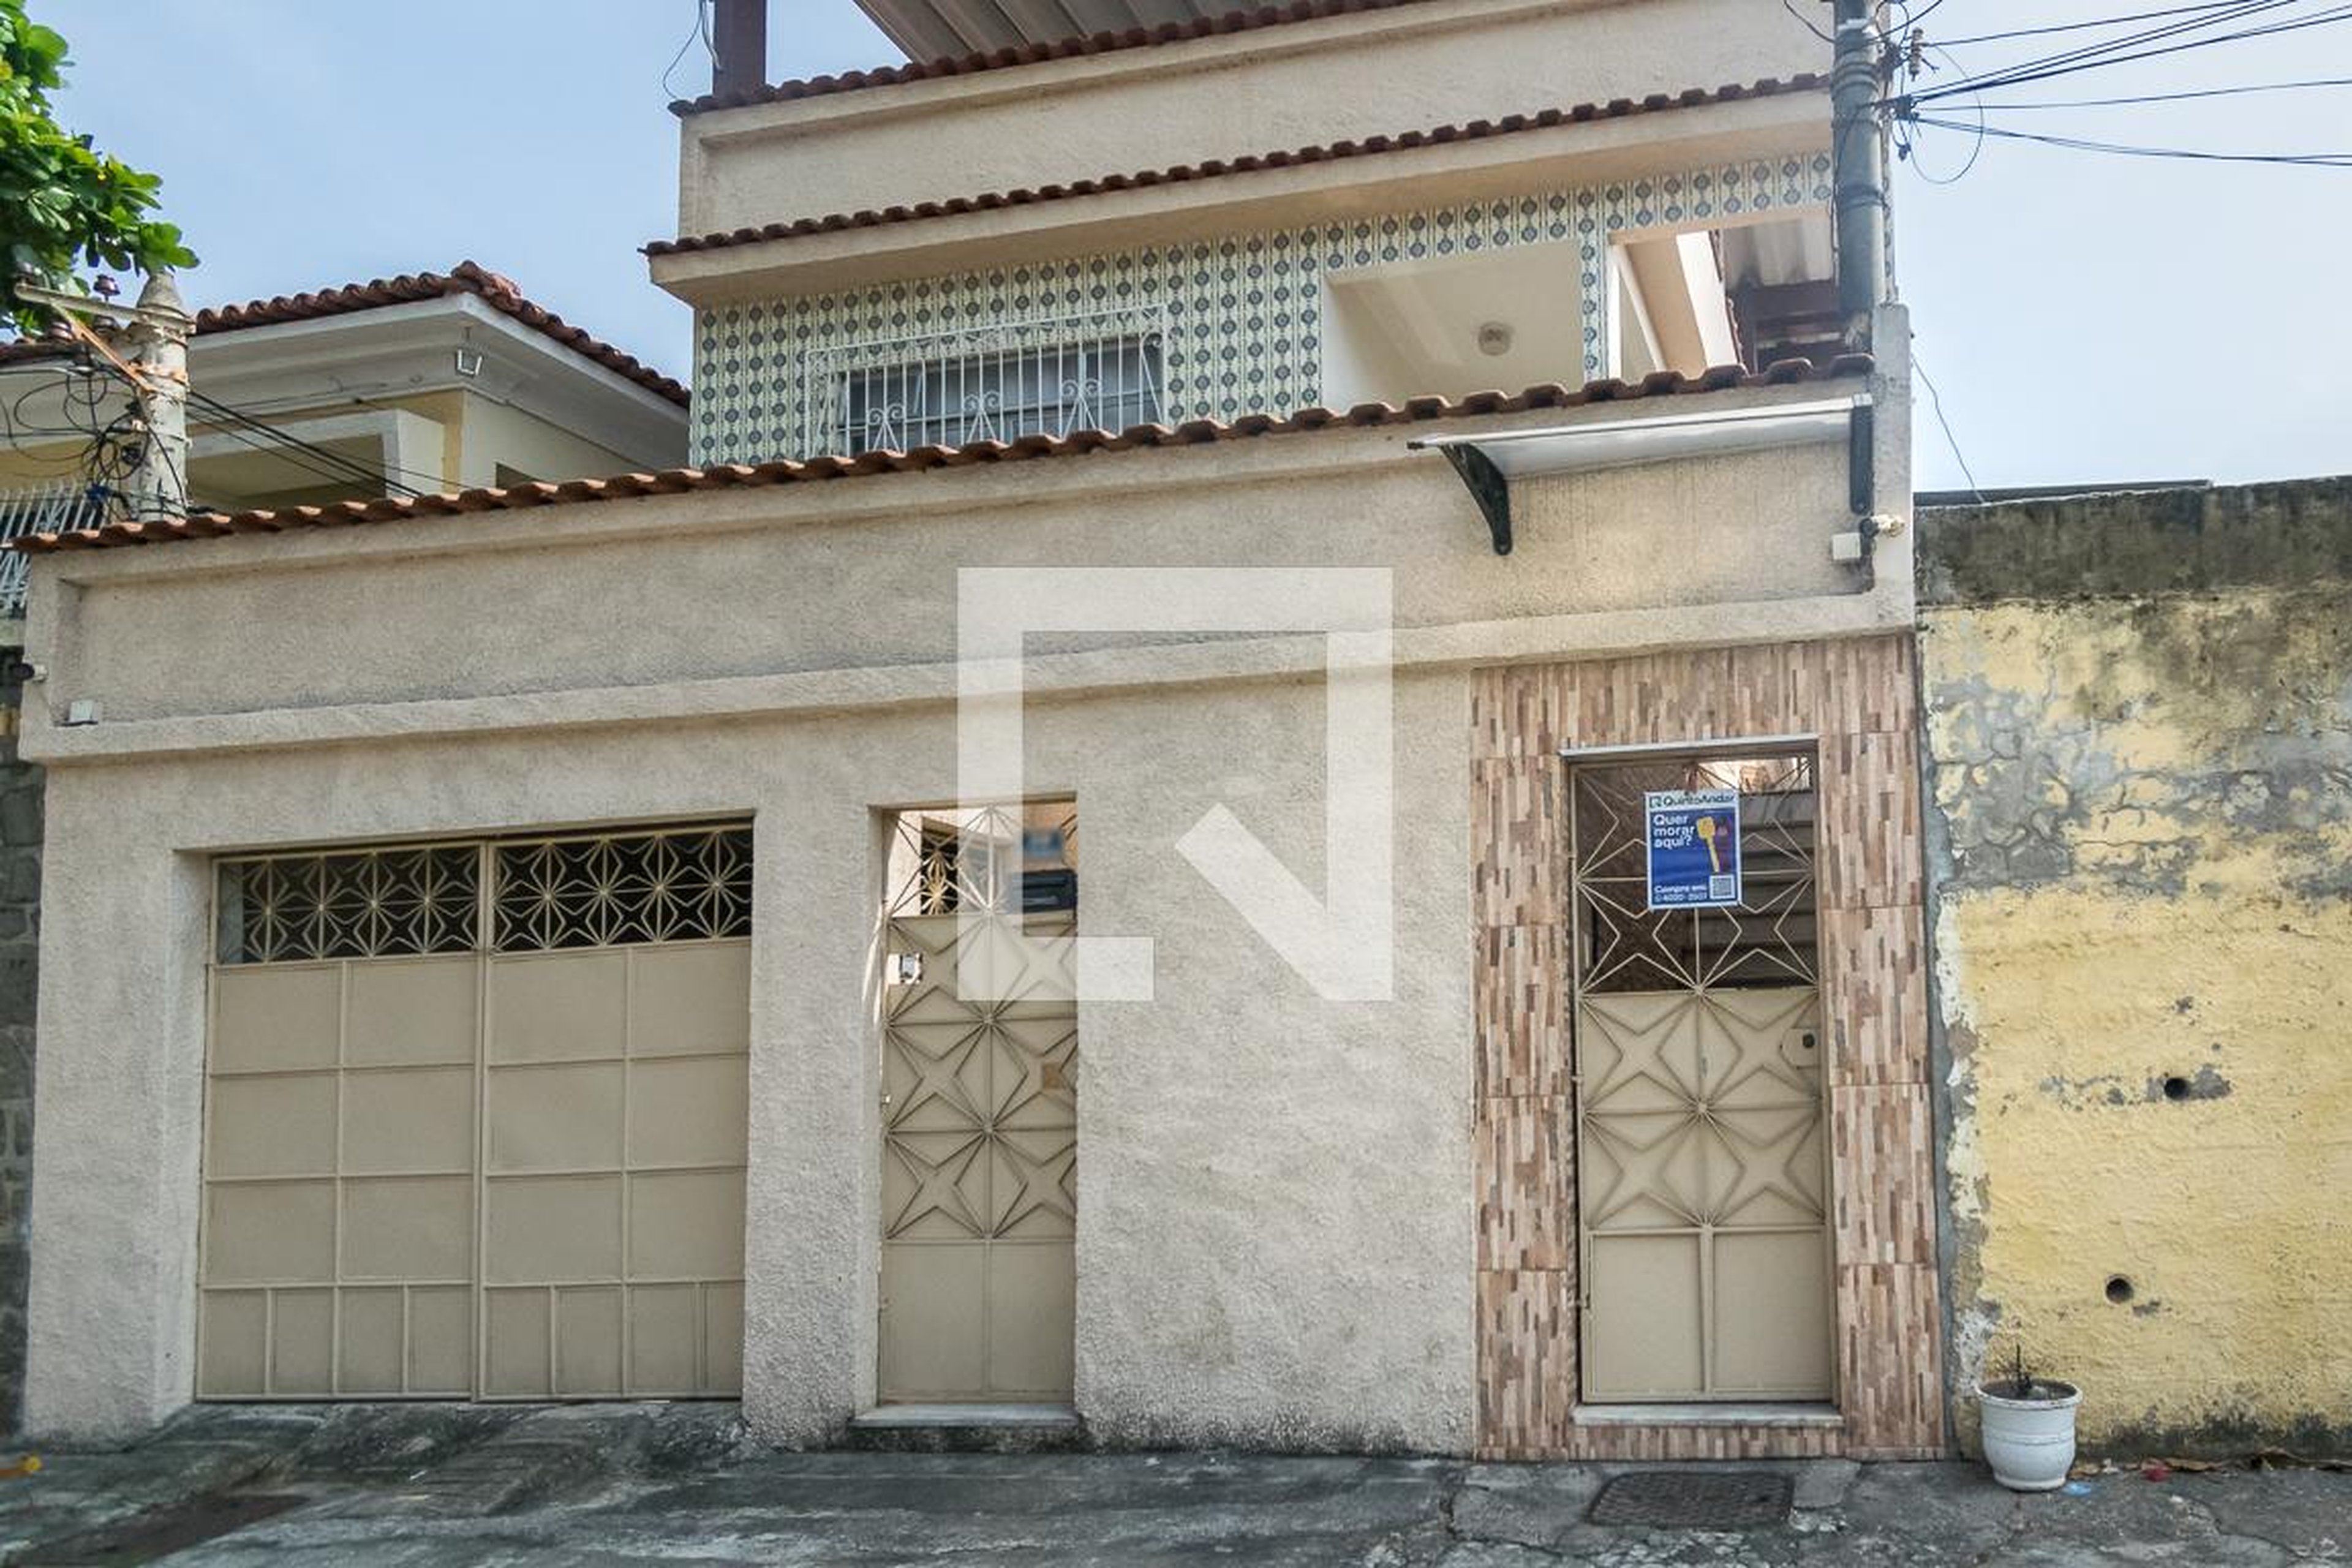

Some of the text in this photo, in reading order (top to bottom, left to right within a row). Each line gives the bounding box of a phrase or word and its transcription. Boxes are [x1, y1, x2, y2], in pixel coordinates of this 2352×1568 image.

[1653, 814, 1688, 826] Quer
[1653, 825, 1695, 837] morar
[1654, 835, 1692, 850] aqui?
